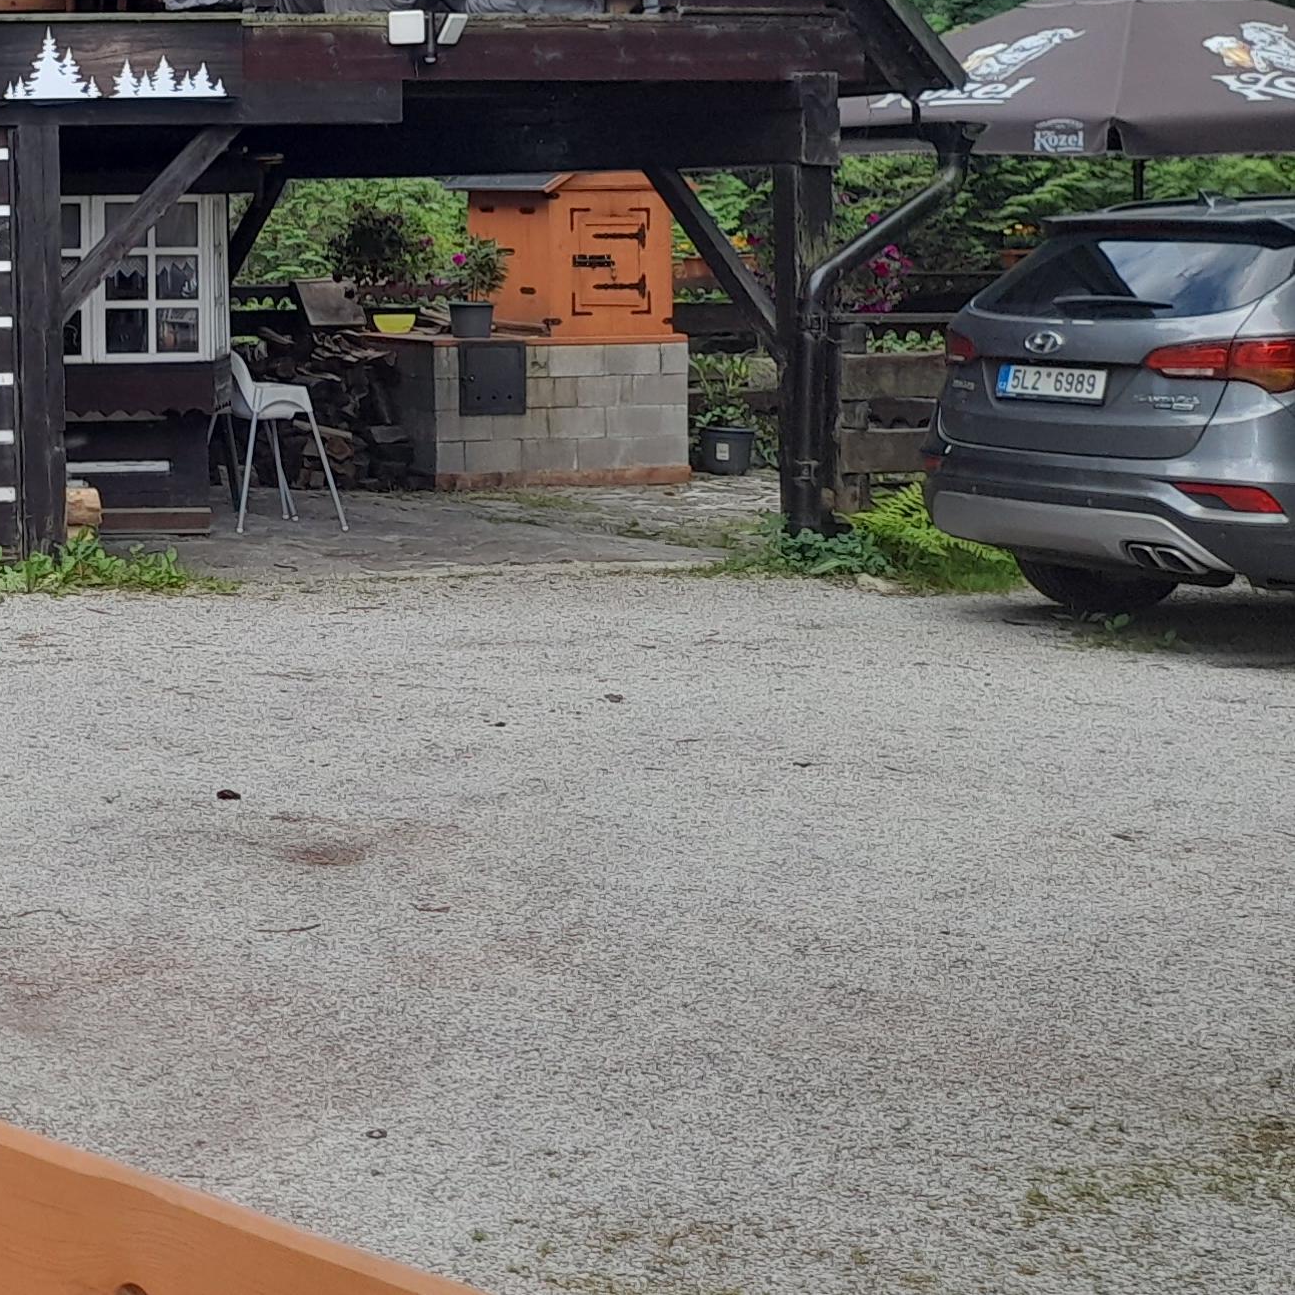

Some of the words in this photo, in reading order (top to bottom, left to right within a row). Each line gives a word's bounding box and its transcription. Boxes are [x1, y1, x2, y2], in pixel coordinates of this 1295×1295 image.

[1033, 130, 1084, 153] Kozel
[1010, 368, 1044, 392] 5L2
[1053, 373, 1097, 395] 6989
